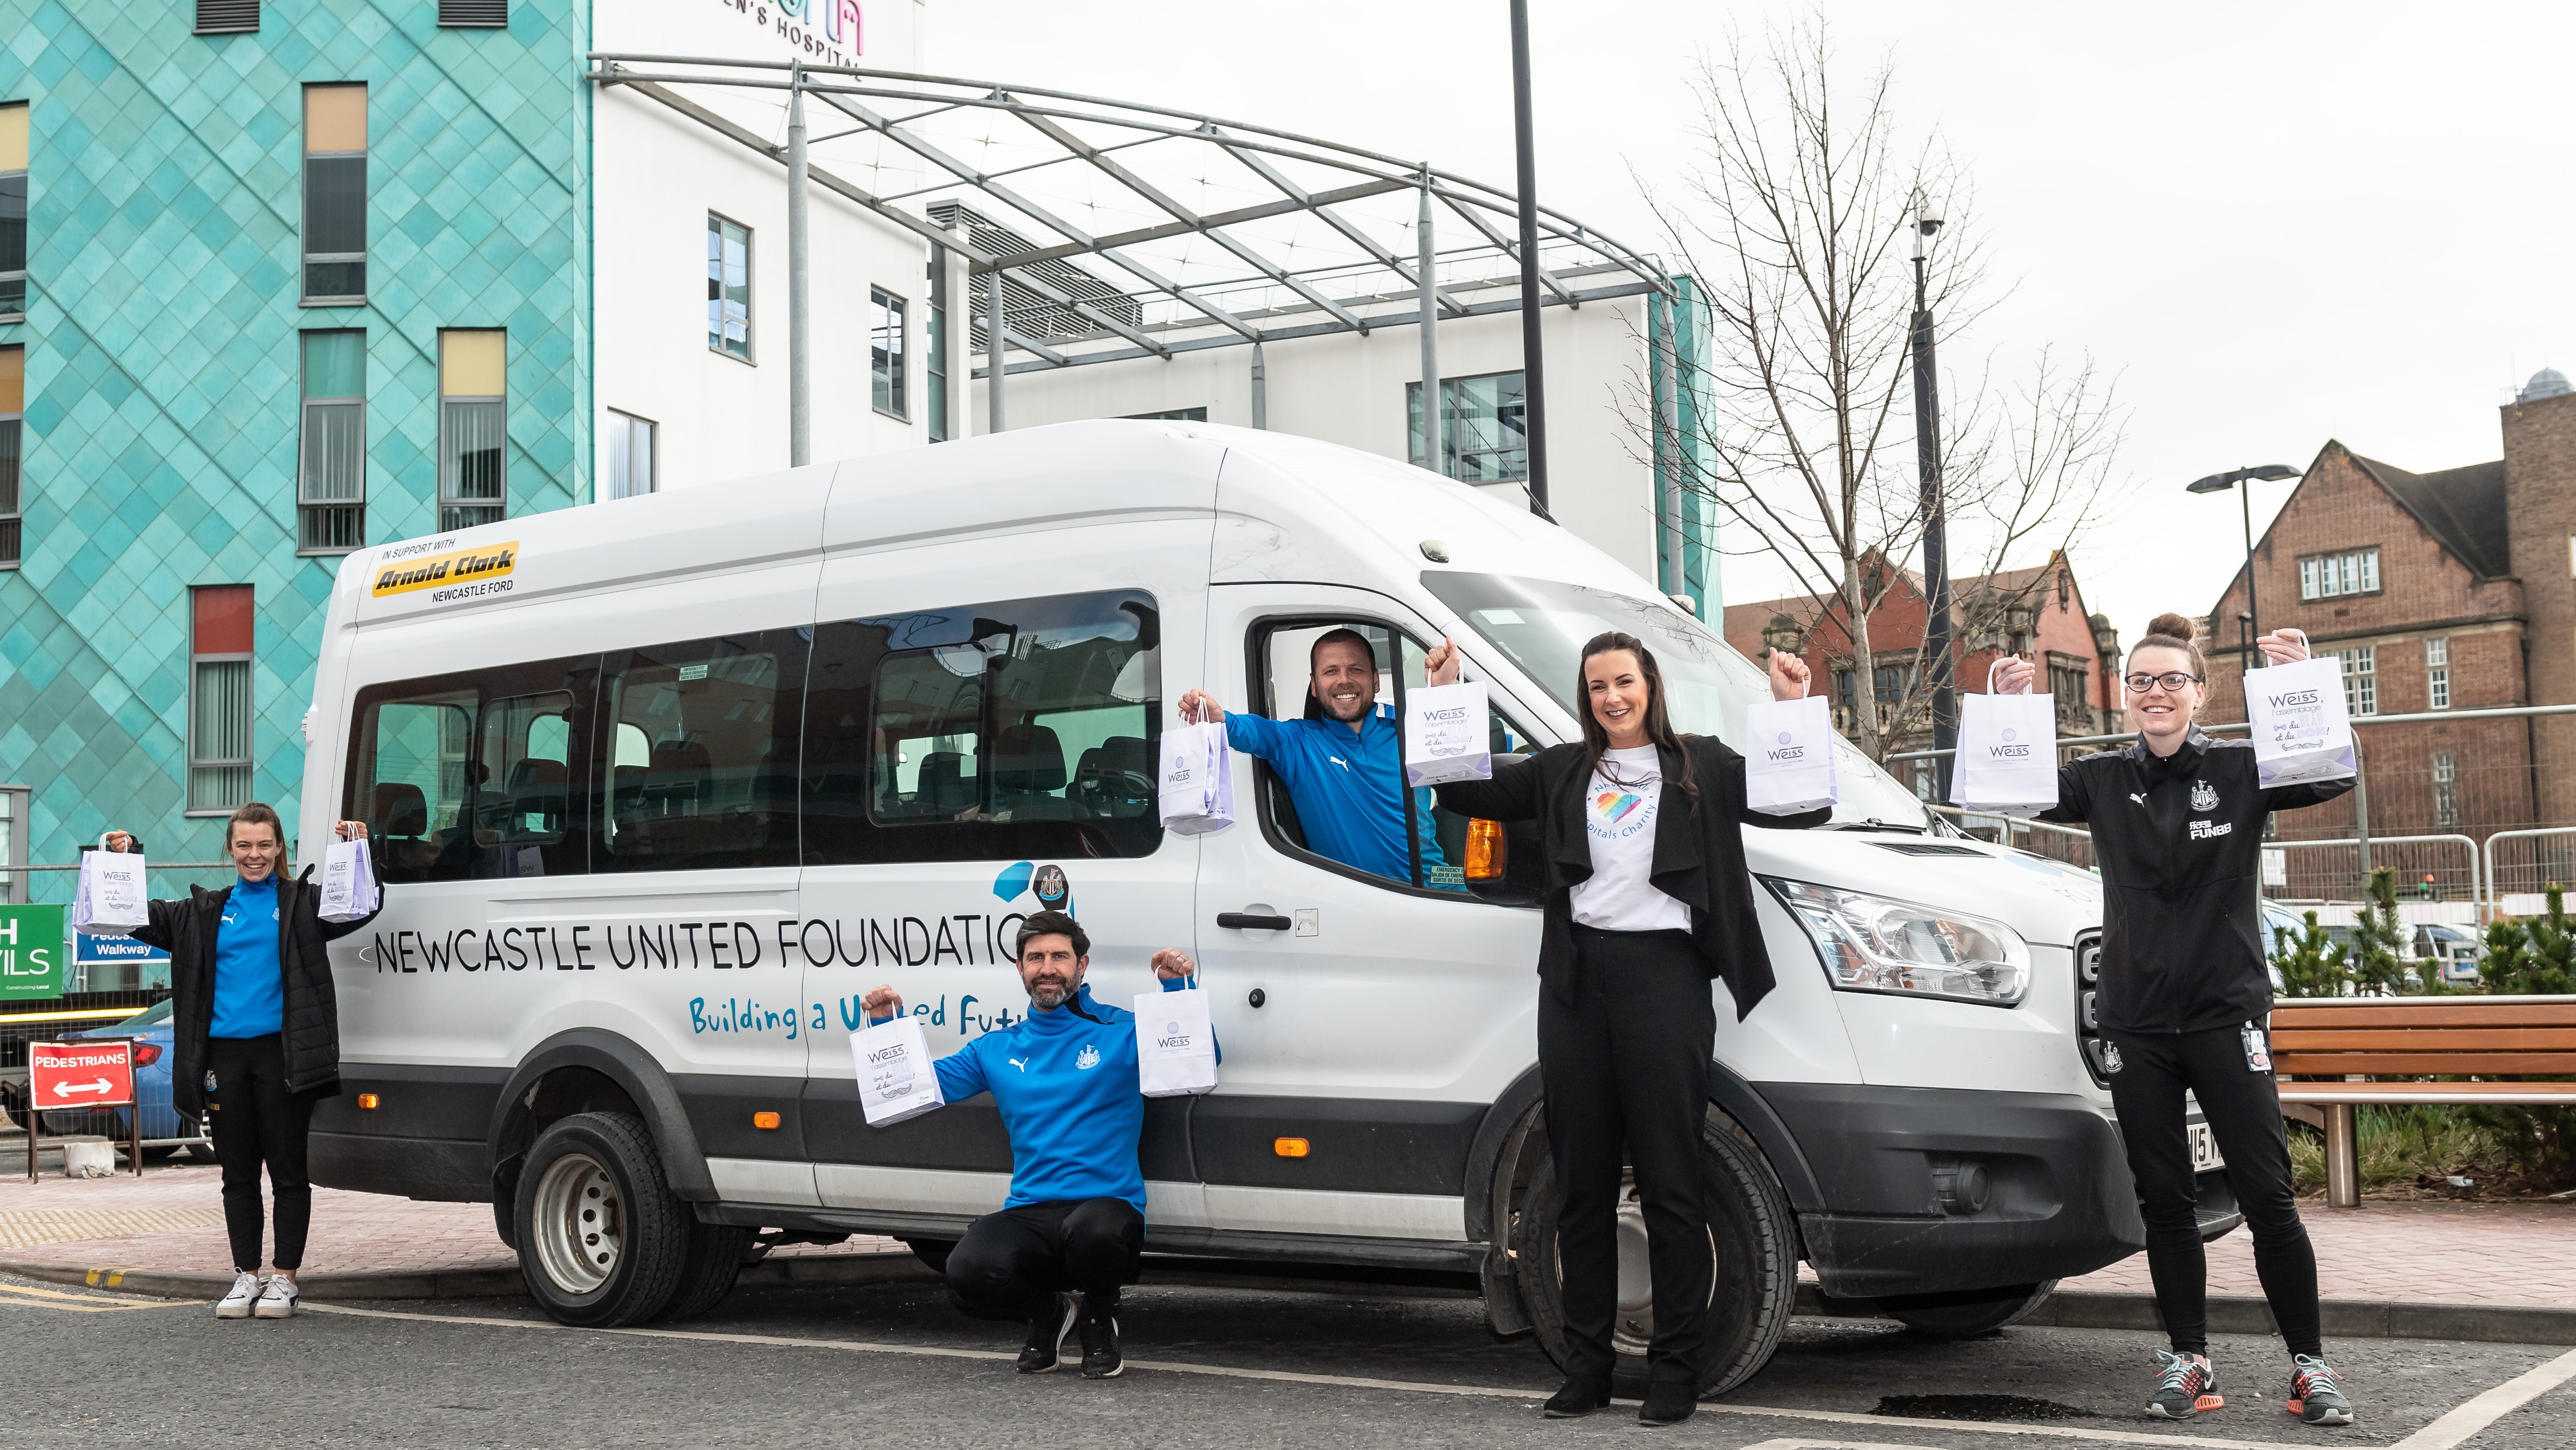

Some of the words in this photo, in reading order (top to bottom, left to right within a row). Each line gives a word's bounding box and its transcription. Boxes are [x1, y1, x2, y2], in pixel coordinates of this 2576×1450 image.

[725, 0, 766, 25] N'S
[382, 551, 391, 560] IN
[392, 543, 433, 558] SUPPORT
[434, 538, 456, 550] WITH
[376, 560, 451, 590] Arnold
[454, 550, 516, 576] Clark
[432, 584, 486, 603] NEWCASTLE
[488, 580, 513, 594] FORD
[2271, 705, 2321, 716] l'assemblage
[1425, 719, 1466, 728] l'assemblage
[2289, 720, 2300, 729] du
[2275, 733, 2283, 741] et
[2284, 731, 2296, 740] du
[1768, 746, 1803, 761] Weiss
[1990, 745, 2029, 758] Weiss
[1168, 769, 1190, 783] Weiss
[1622, 804, 1656, 837] Charity
[96, 944, 151, 956] Walkway
[375, 925, 596, 973] NEWCASTLE
[606, 921, 761, 970] UNITED
[778, 913, 1027, 968] FOUNDATIO
[0, 949, 50, 975] ILS
[689, 996, 796, 1040] Building
[811, 1004, 826, 1031] a
[839, 993, 946, 1031] Ued
[1157, 1036, 1190, 1049] Weiss
[35, 1053, 126, 1068] PEDESTRIANS
[871, 1056, 908, 1070] l'assemblage
